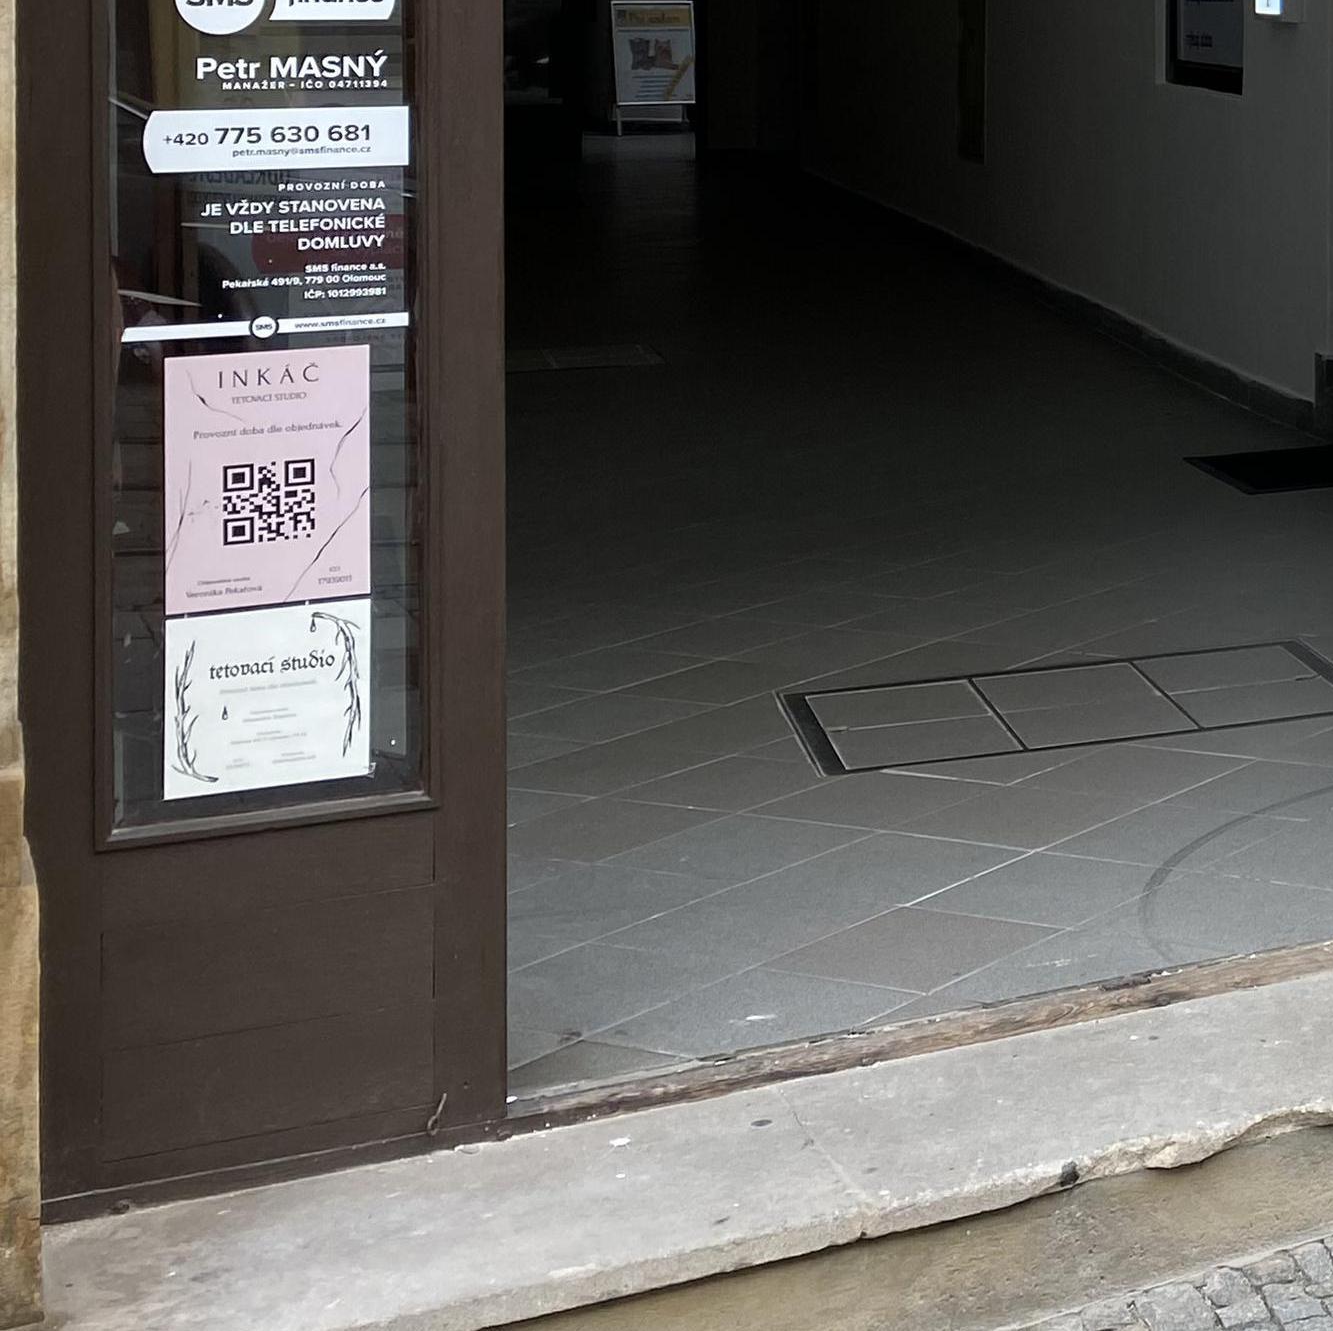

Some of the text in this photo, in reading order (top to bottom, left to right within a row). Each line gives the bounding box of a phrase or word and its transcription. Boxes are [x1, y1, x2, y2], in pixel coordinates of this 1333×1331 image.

[196, 49, 388, 80] Petr MASNÝ
[222, 79, 388, 91] MANAŽER IČO 04711394
[163, 124, 371, 147] +420 775 630 681
[278, 180, 386, 191] PROVOZNÍ DOBA
[201, 197, 386, 217] JE VŽDY STANOVENA
[230, 213, 386, 235] DLE TELEFONICKÉ
[297, 235, 386, 251] DOMLUVY
[305, 263, 328, 274] SMS
[331, 262, 367, 272] finance
[305, 275, 324, 285] 779
[326, 275, 340, 284] 00
[342, 274, 386, 283] Olomouc
[218, 362, 320, 389] INKÁČ
[209, 649, 336, 679] tetovací studio
